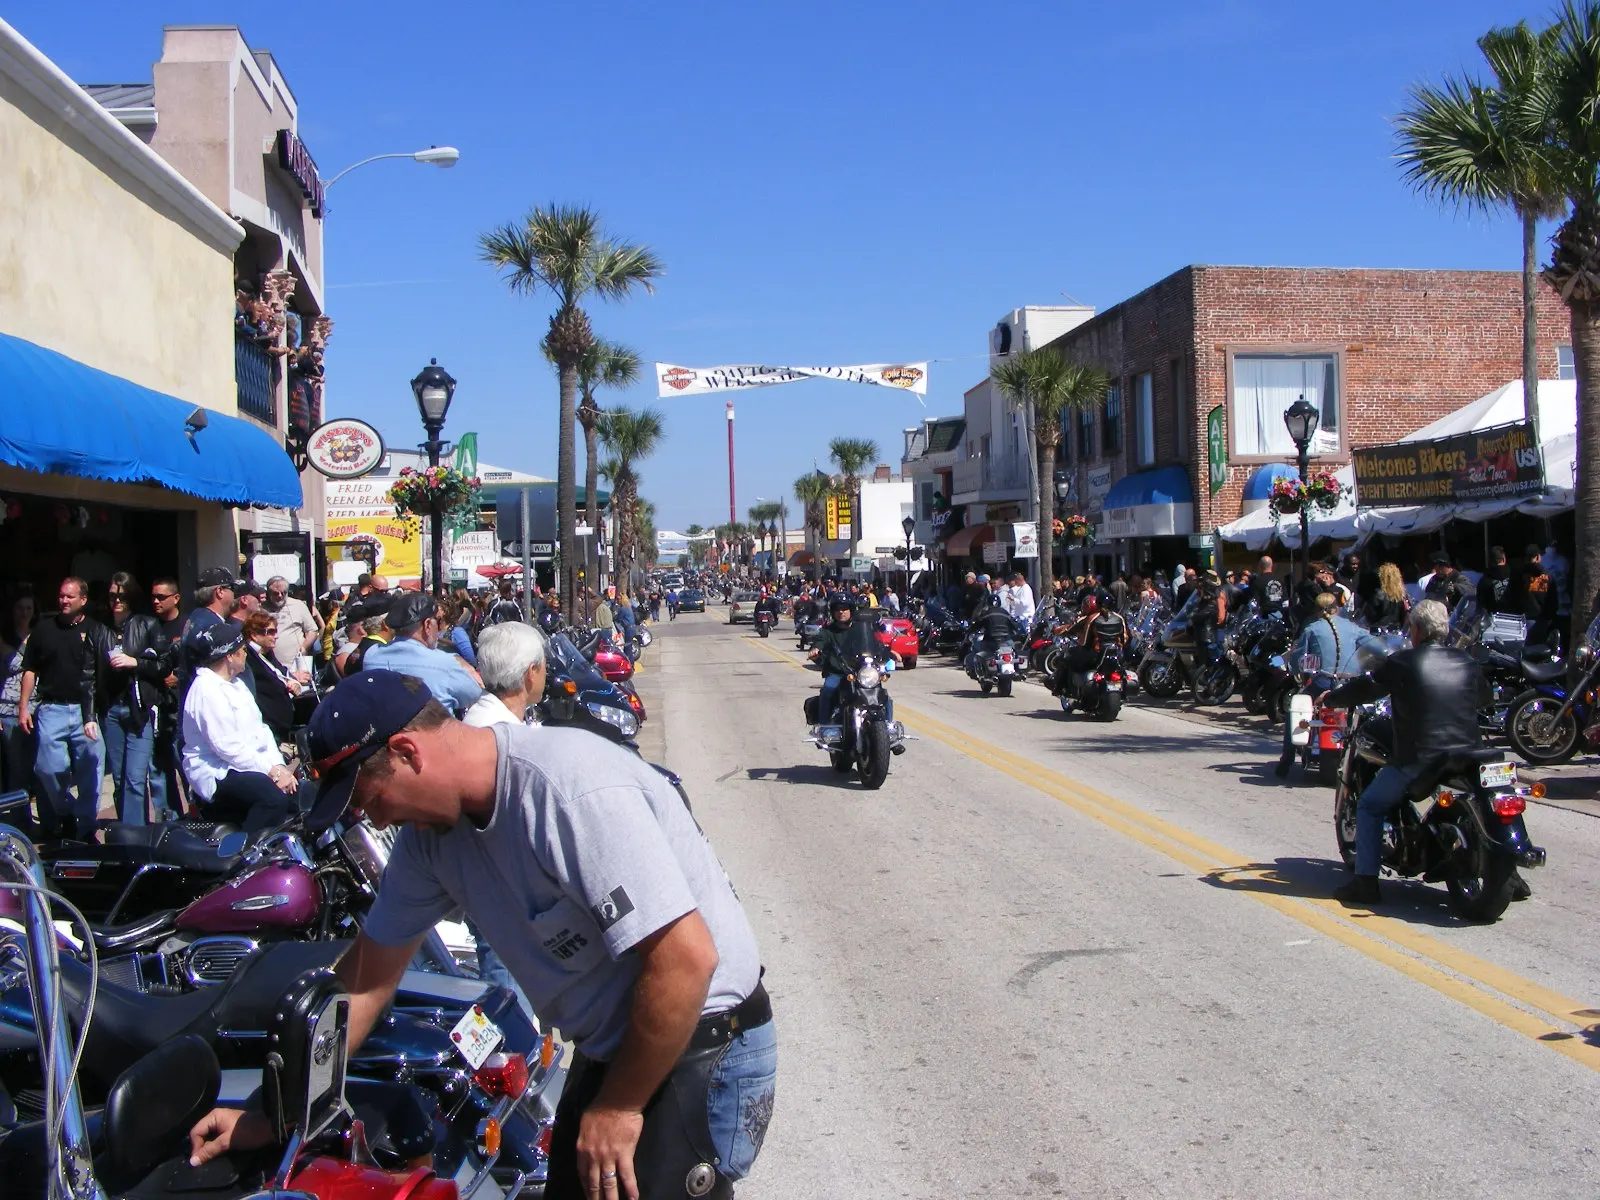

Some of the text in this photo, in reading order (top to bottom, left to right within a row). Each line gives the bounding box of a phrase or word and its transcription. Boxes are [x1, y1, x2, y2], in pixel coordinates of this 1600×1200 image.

[1210, 419, 1226, 483] ATM
[1355, 447, 1466, 478] Welcome Bikers
[338, 484, 372, 493] FRIED
[1358, 479, 1453, 499] EVENT MERCHANDISE
[358, 495, 391, 505] BEAN
[462, 555, 485, 564] PITA
